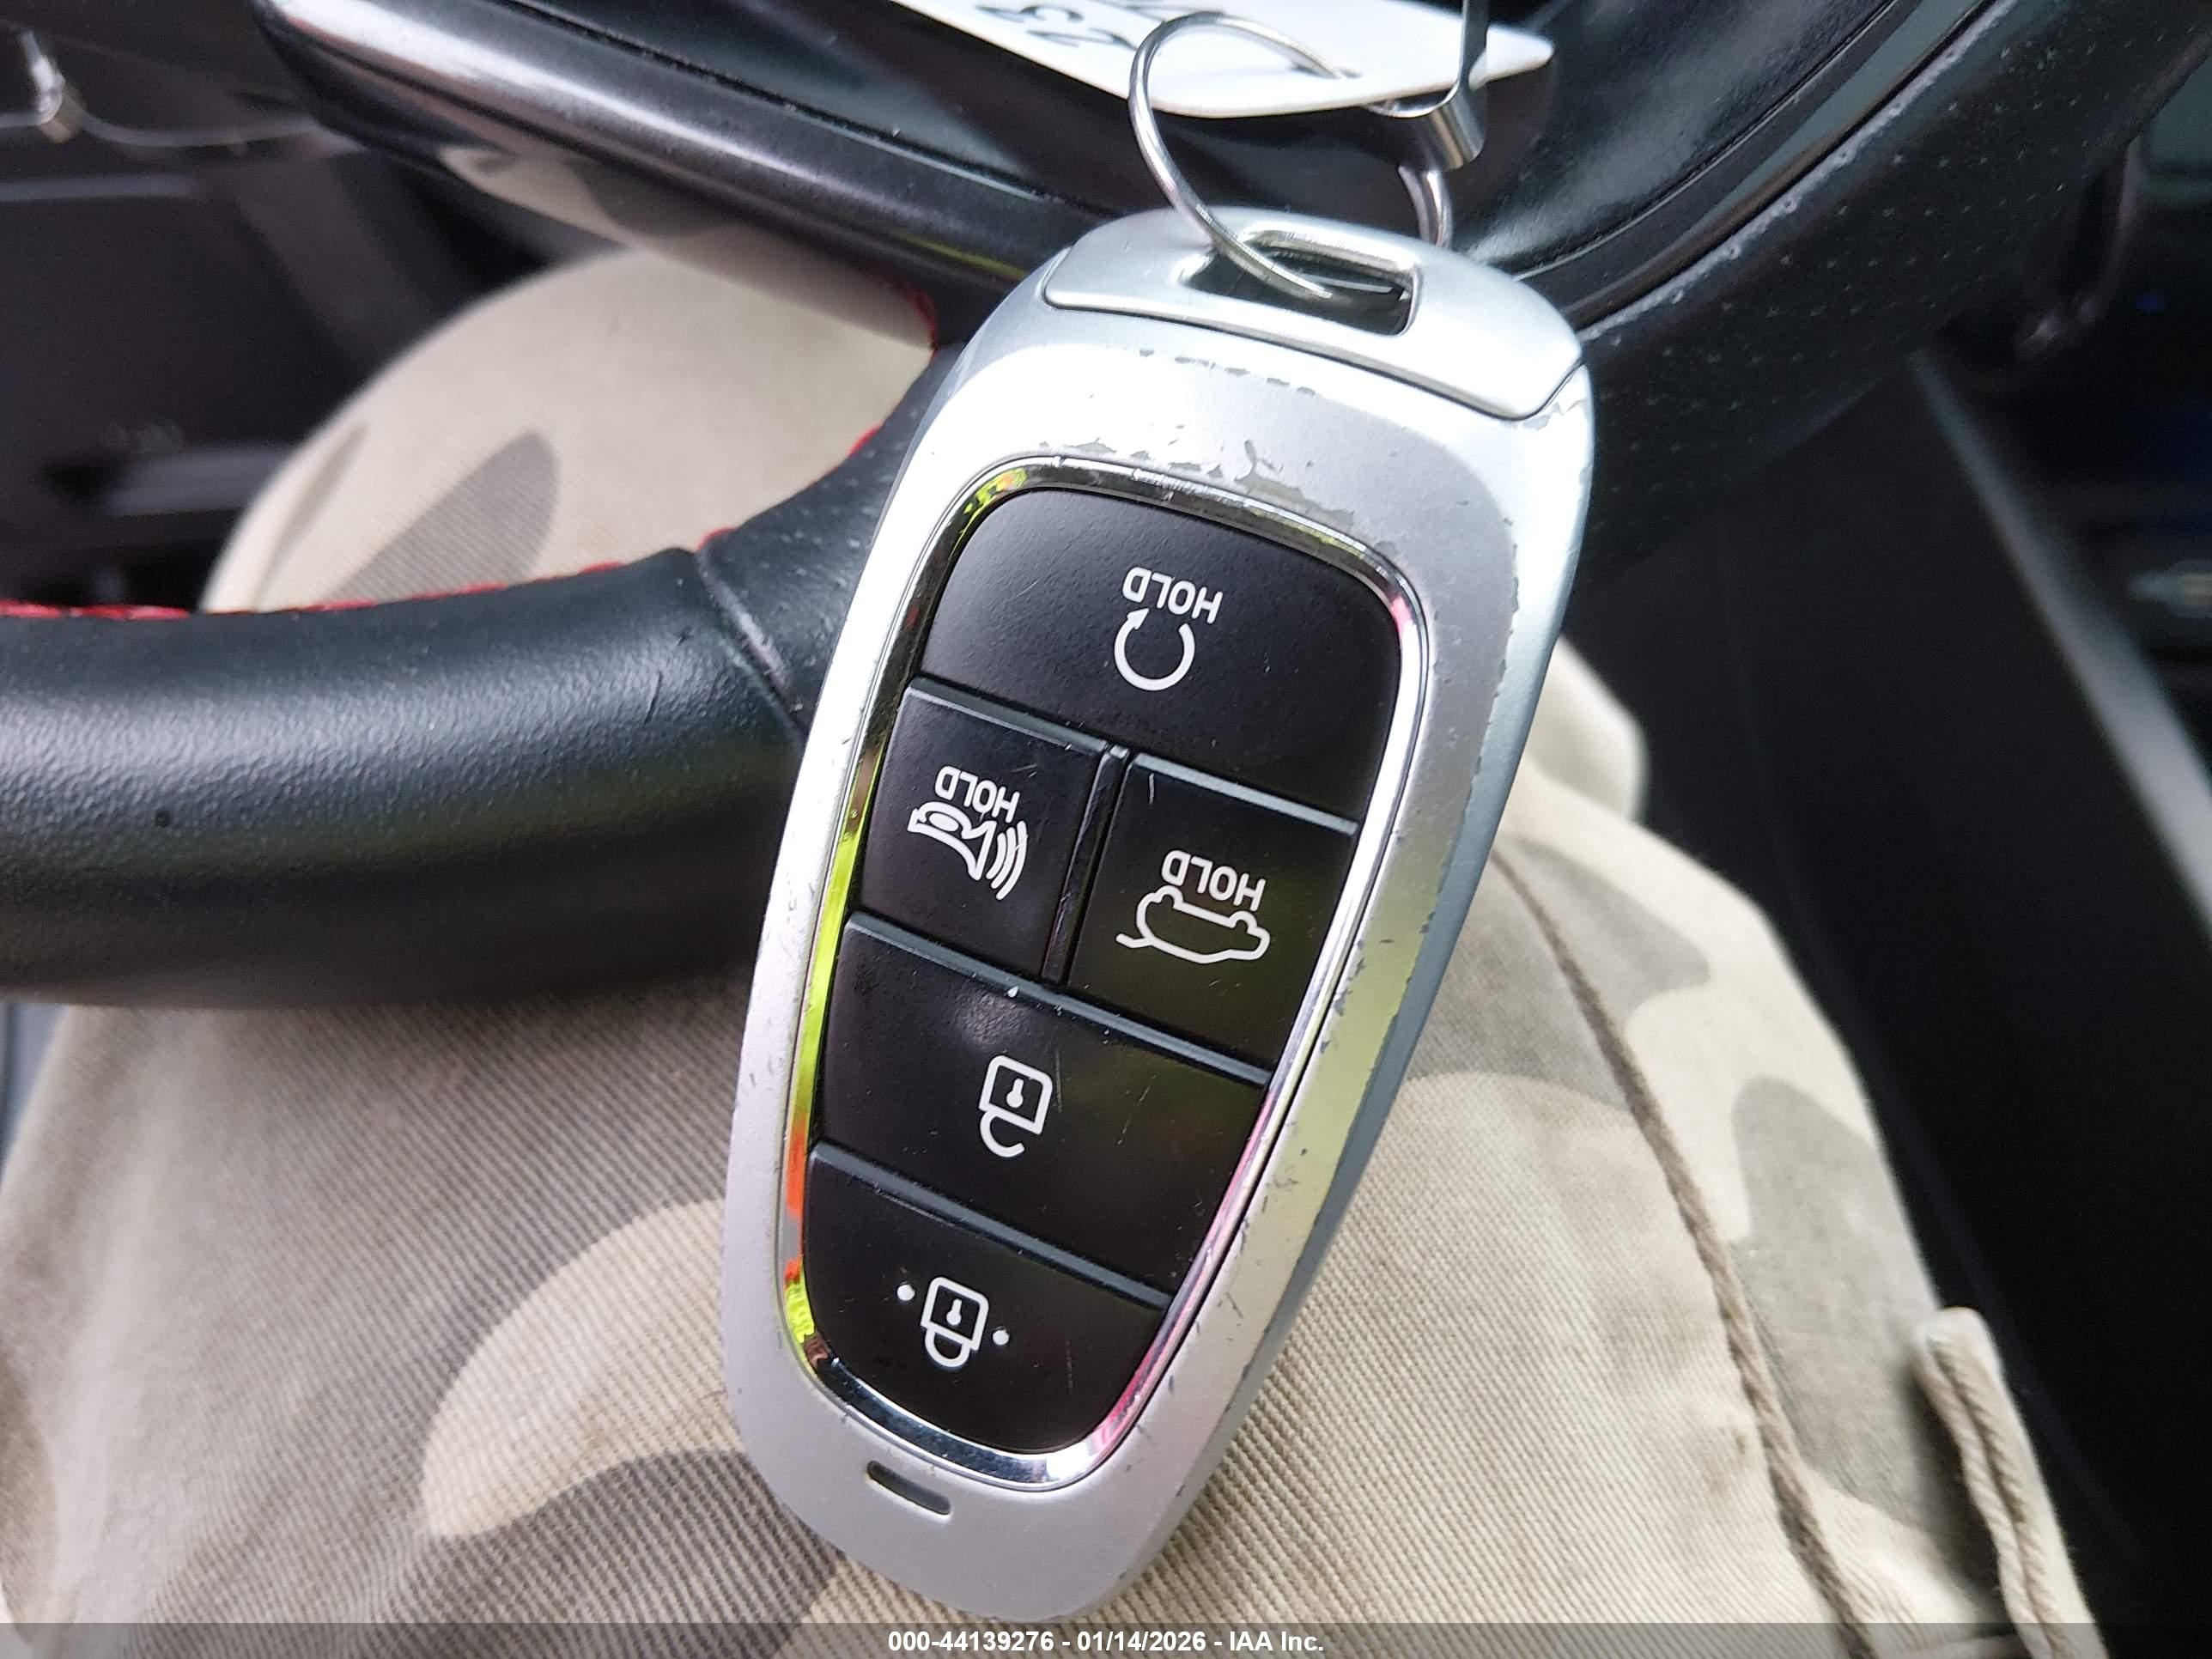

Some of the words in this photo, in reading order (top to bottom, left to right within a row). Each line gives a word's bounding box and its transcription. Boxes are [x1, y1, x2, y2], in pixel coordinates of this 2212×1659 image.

[1121, 566, 1224, 624] HOLD
[934, 765, 1020, 823] HOLD
[1161, 849, 1267, 912] HOLD
